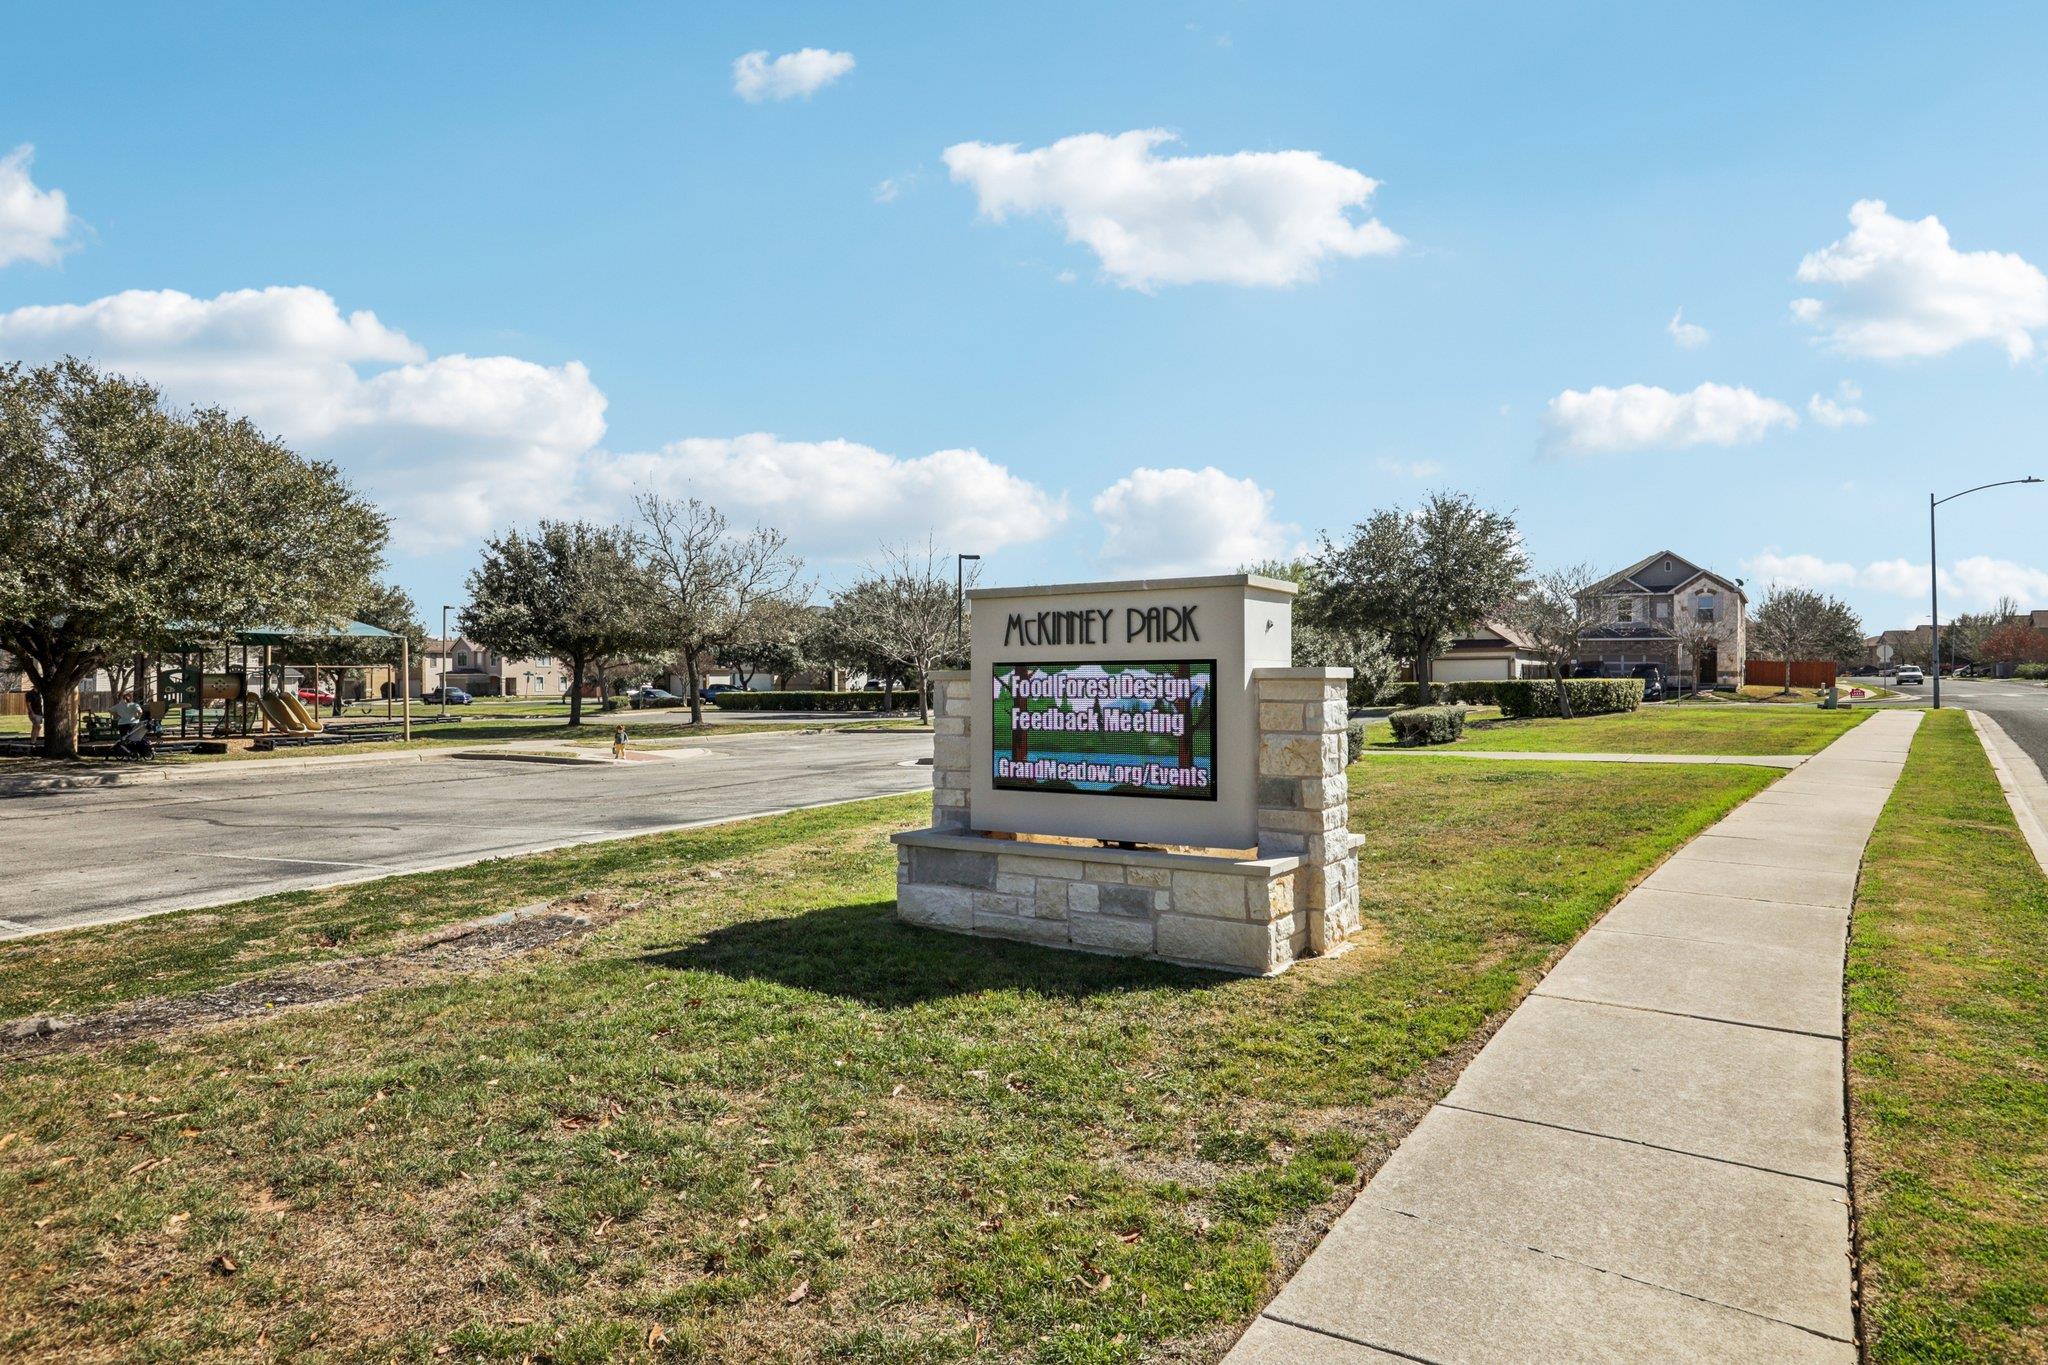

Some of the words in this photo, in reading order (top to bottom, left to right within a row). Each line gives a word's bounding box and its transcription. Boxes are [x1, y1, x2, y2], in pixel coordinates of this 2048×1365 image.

[1126, 605, 1200, 643] PARK
[1011, 675, 1053, 698] Food
[1057, 675, 1117, 699] Forest
[1121, 673, 1190, 702] Design
[1011, 708, 1099, 731] Feedback
[1103, 709, 1184, 736] Meeting
[998, 758, 1207, 787] GrandMeadow.org/Events
